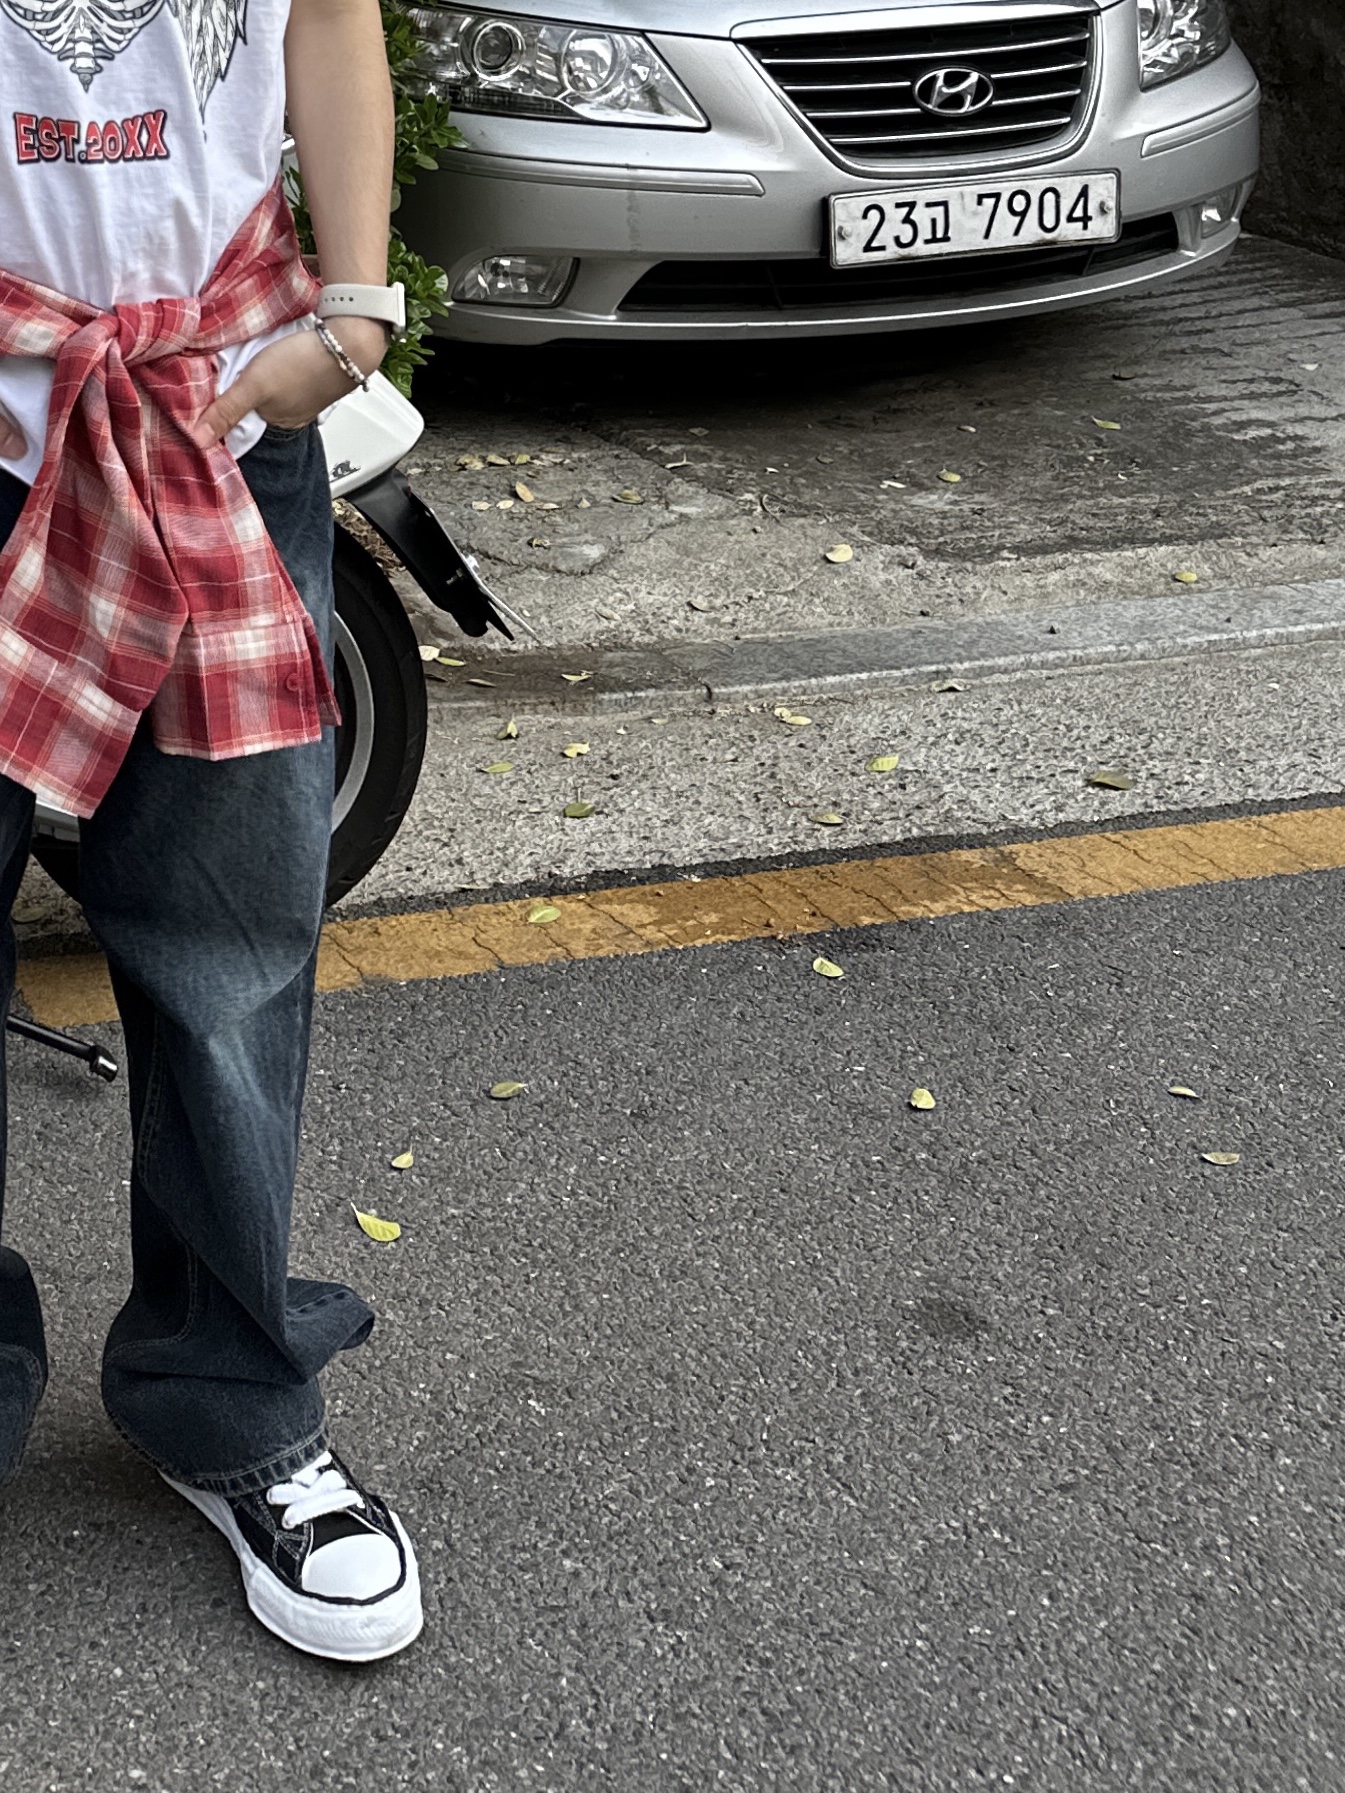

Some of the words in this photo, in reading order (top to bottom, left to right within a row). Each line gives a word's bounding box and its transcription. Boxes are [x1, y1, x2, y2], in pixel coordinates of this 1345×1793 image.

[13, 109, 171, 165] EST.20XX
[861, 199, 951, 253] 23고
[976, 183, 1093, 240] 7904
